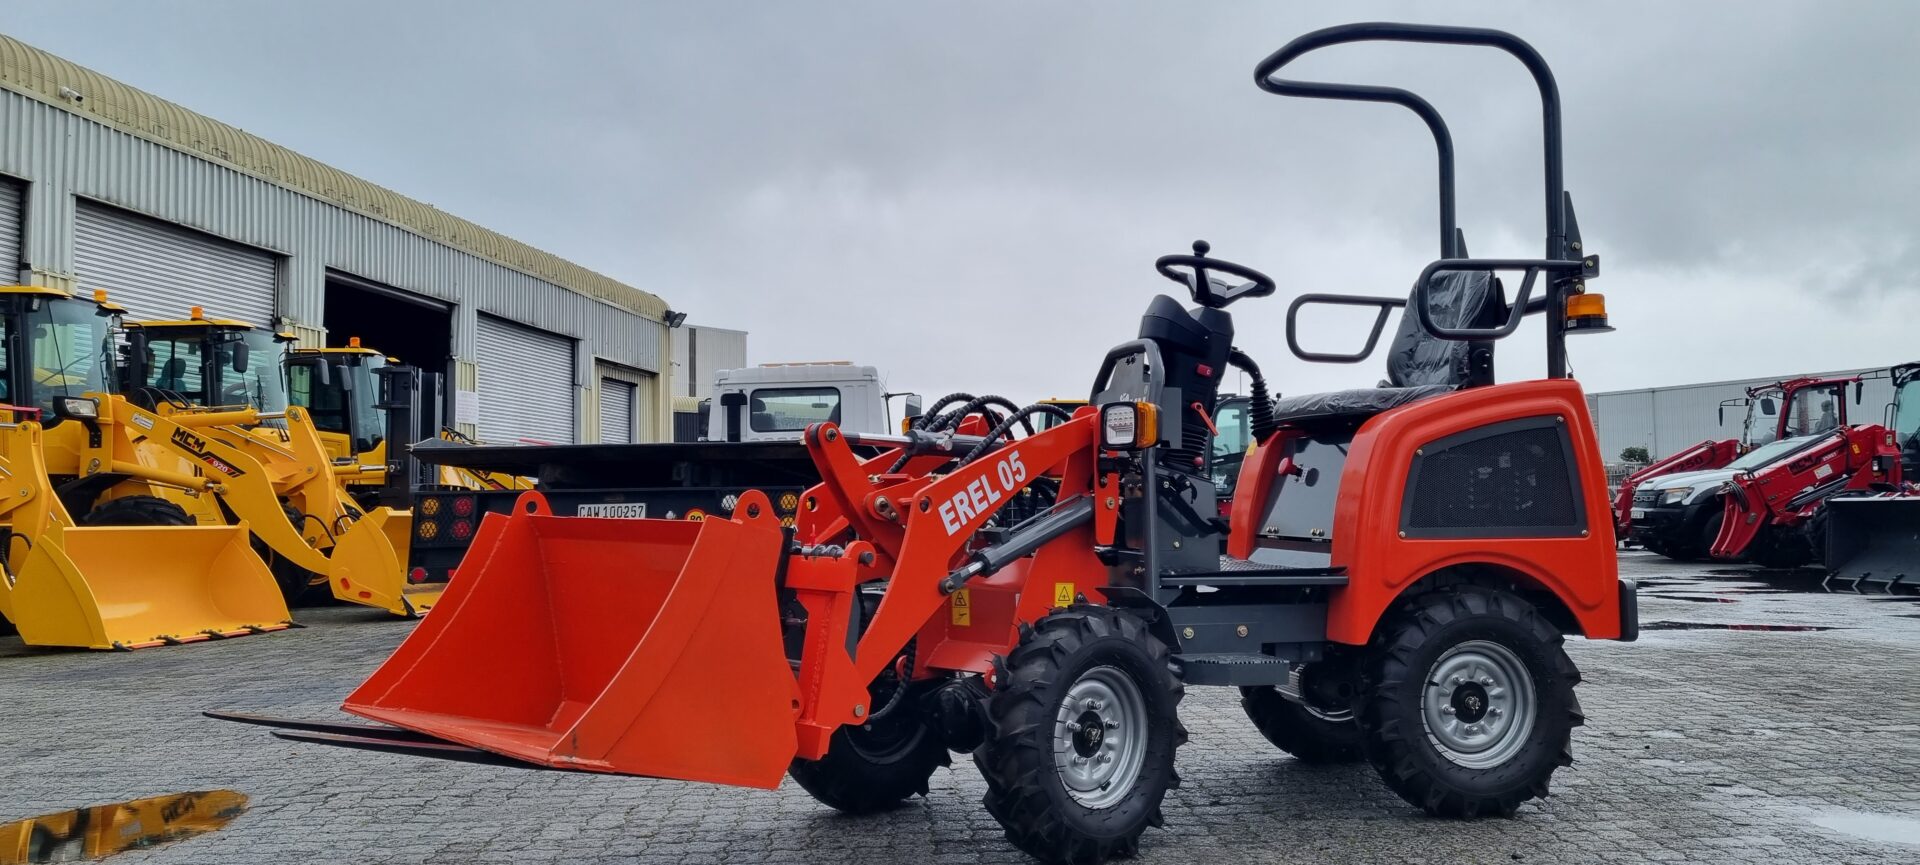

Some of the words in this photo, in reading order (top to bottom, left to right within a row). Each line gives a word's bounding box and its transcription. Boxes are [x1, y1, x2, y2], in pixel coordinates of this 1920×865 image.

[172, 426, 206, 453] MCM
[212, 460, 228, 472] 920
[938, 474, 1001, 536] EREL
[997, 450, 1026, 491] 05
[580, 506, 600, 518] CAW
